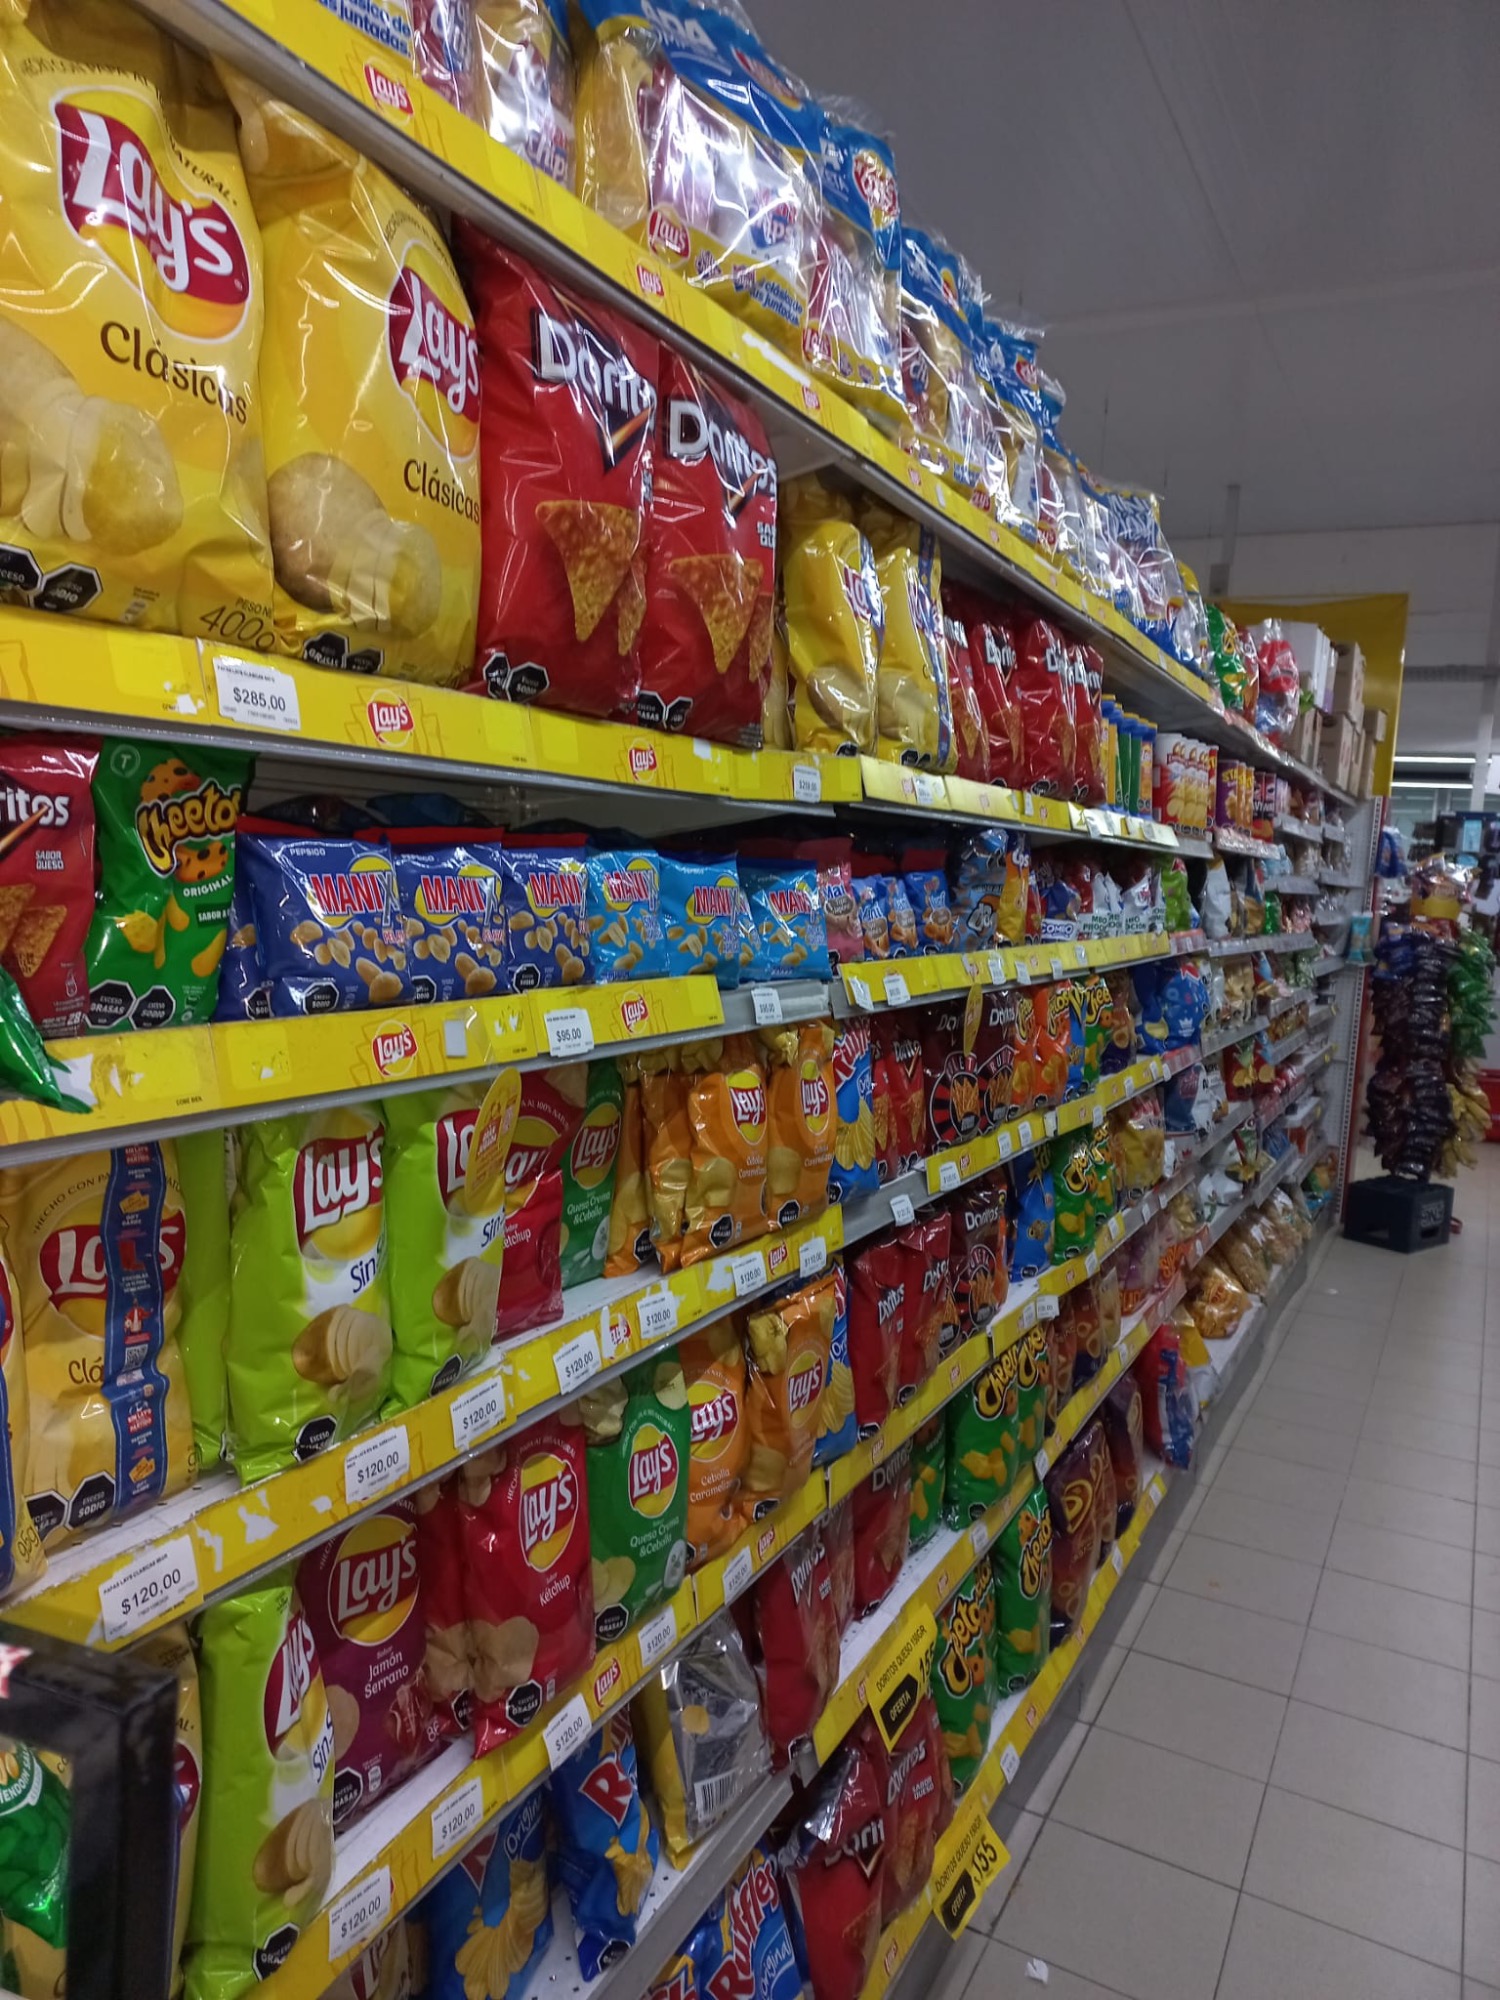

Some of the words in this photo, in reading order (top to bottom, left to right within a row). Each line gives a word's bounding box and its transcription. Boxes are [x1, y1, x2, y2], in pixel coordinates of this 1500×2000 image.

[72, 108, 235, 293] Lay's
[399, 271, 479, 415] Lay's
[100, 320, 248, 426] Clásicas
[403, 460, 480, 525] Clásicas
[232, 686, 287, 712] $285,00
[182, 874, 233, 898] ORIGINAL
[575, 1121, 619, 1173] Lay's
[67, 1175, 97, 1195] CON
[462, 1399, 497, 1430] $120,00
[356, 1451, 400, 1484] $120,00
[633, 1437, 672, 1498] Lay's
[524, 1469, 573, 1554] Lay's
[120, 1567, 182, 1616] $120,00
[337, 1533, 417, 1624] Lay's
[364, 1664, 410, 1700] Serrano
[368, 1650, 404, 1681] Jamón
[888, 1690, 912, 1723] OFERTA
